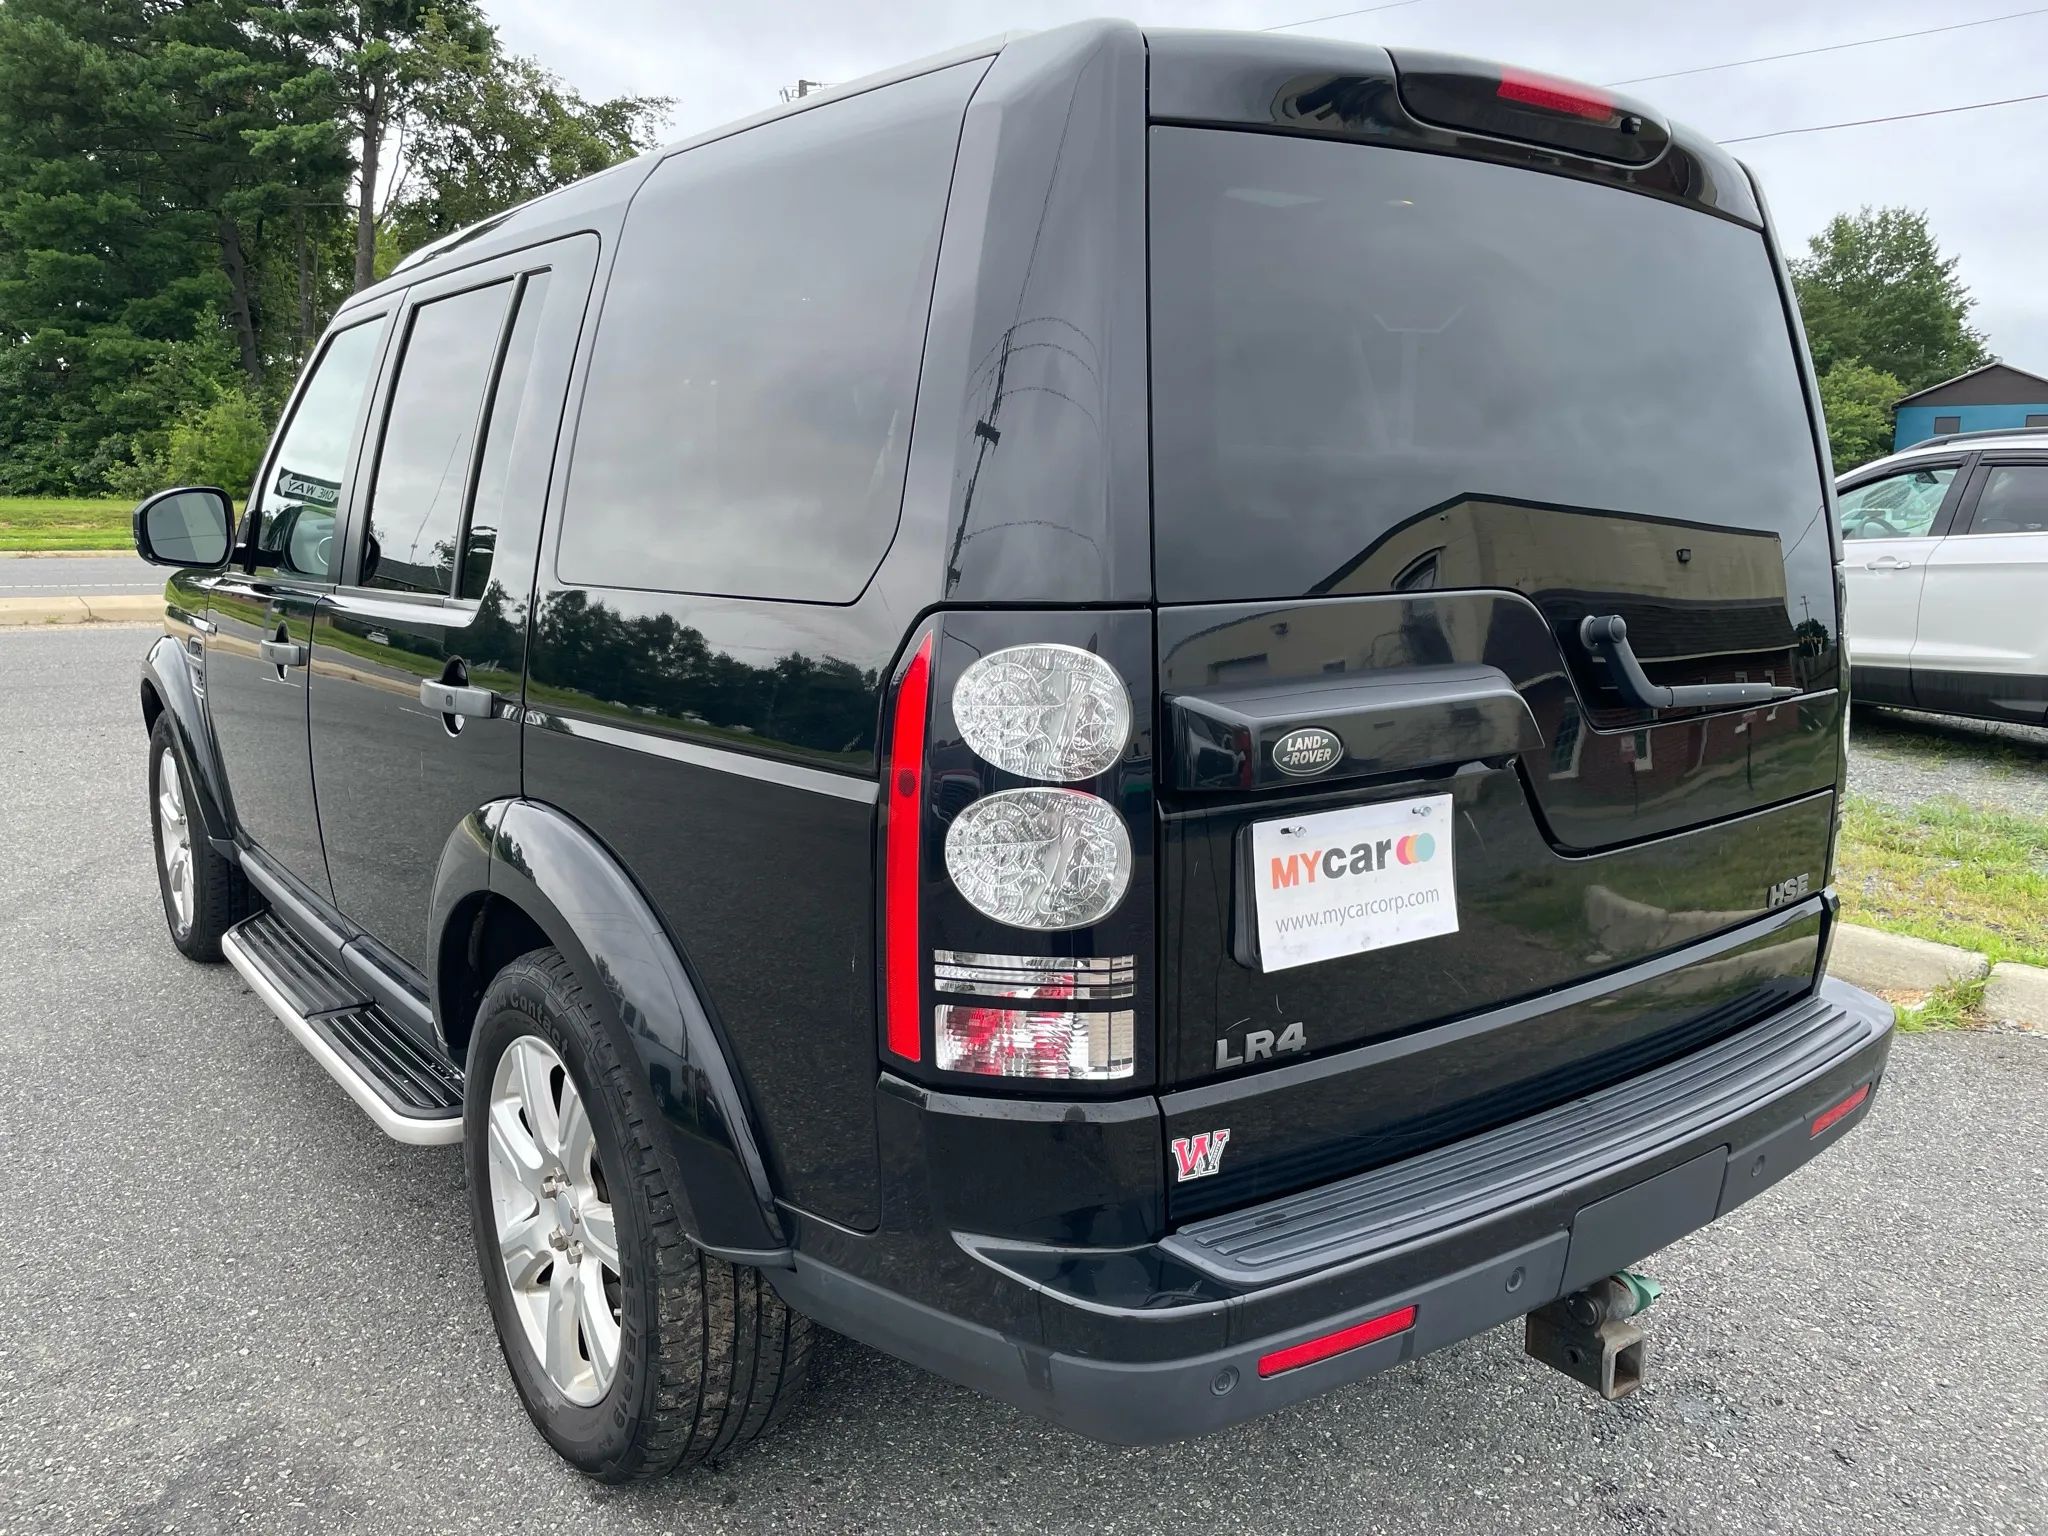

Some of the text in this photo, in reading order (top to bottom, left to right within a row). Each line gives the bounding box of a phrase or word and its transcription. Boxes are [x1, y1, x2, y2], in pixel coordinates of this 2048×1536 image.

[1286, 735, 1322, 751] LAND
[1290, 748, 1332, 766] ROVER
[1271, 838, 1392, 890] MYcar
[1275, 887, 1440, 934] www.mycarcorp.com
[1766, 872, 1809, 909] HSE
[1215, 1021, 1307, 1070] LR4
